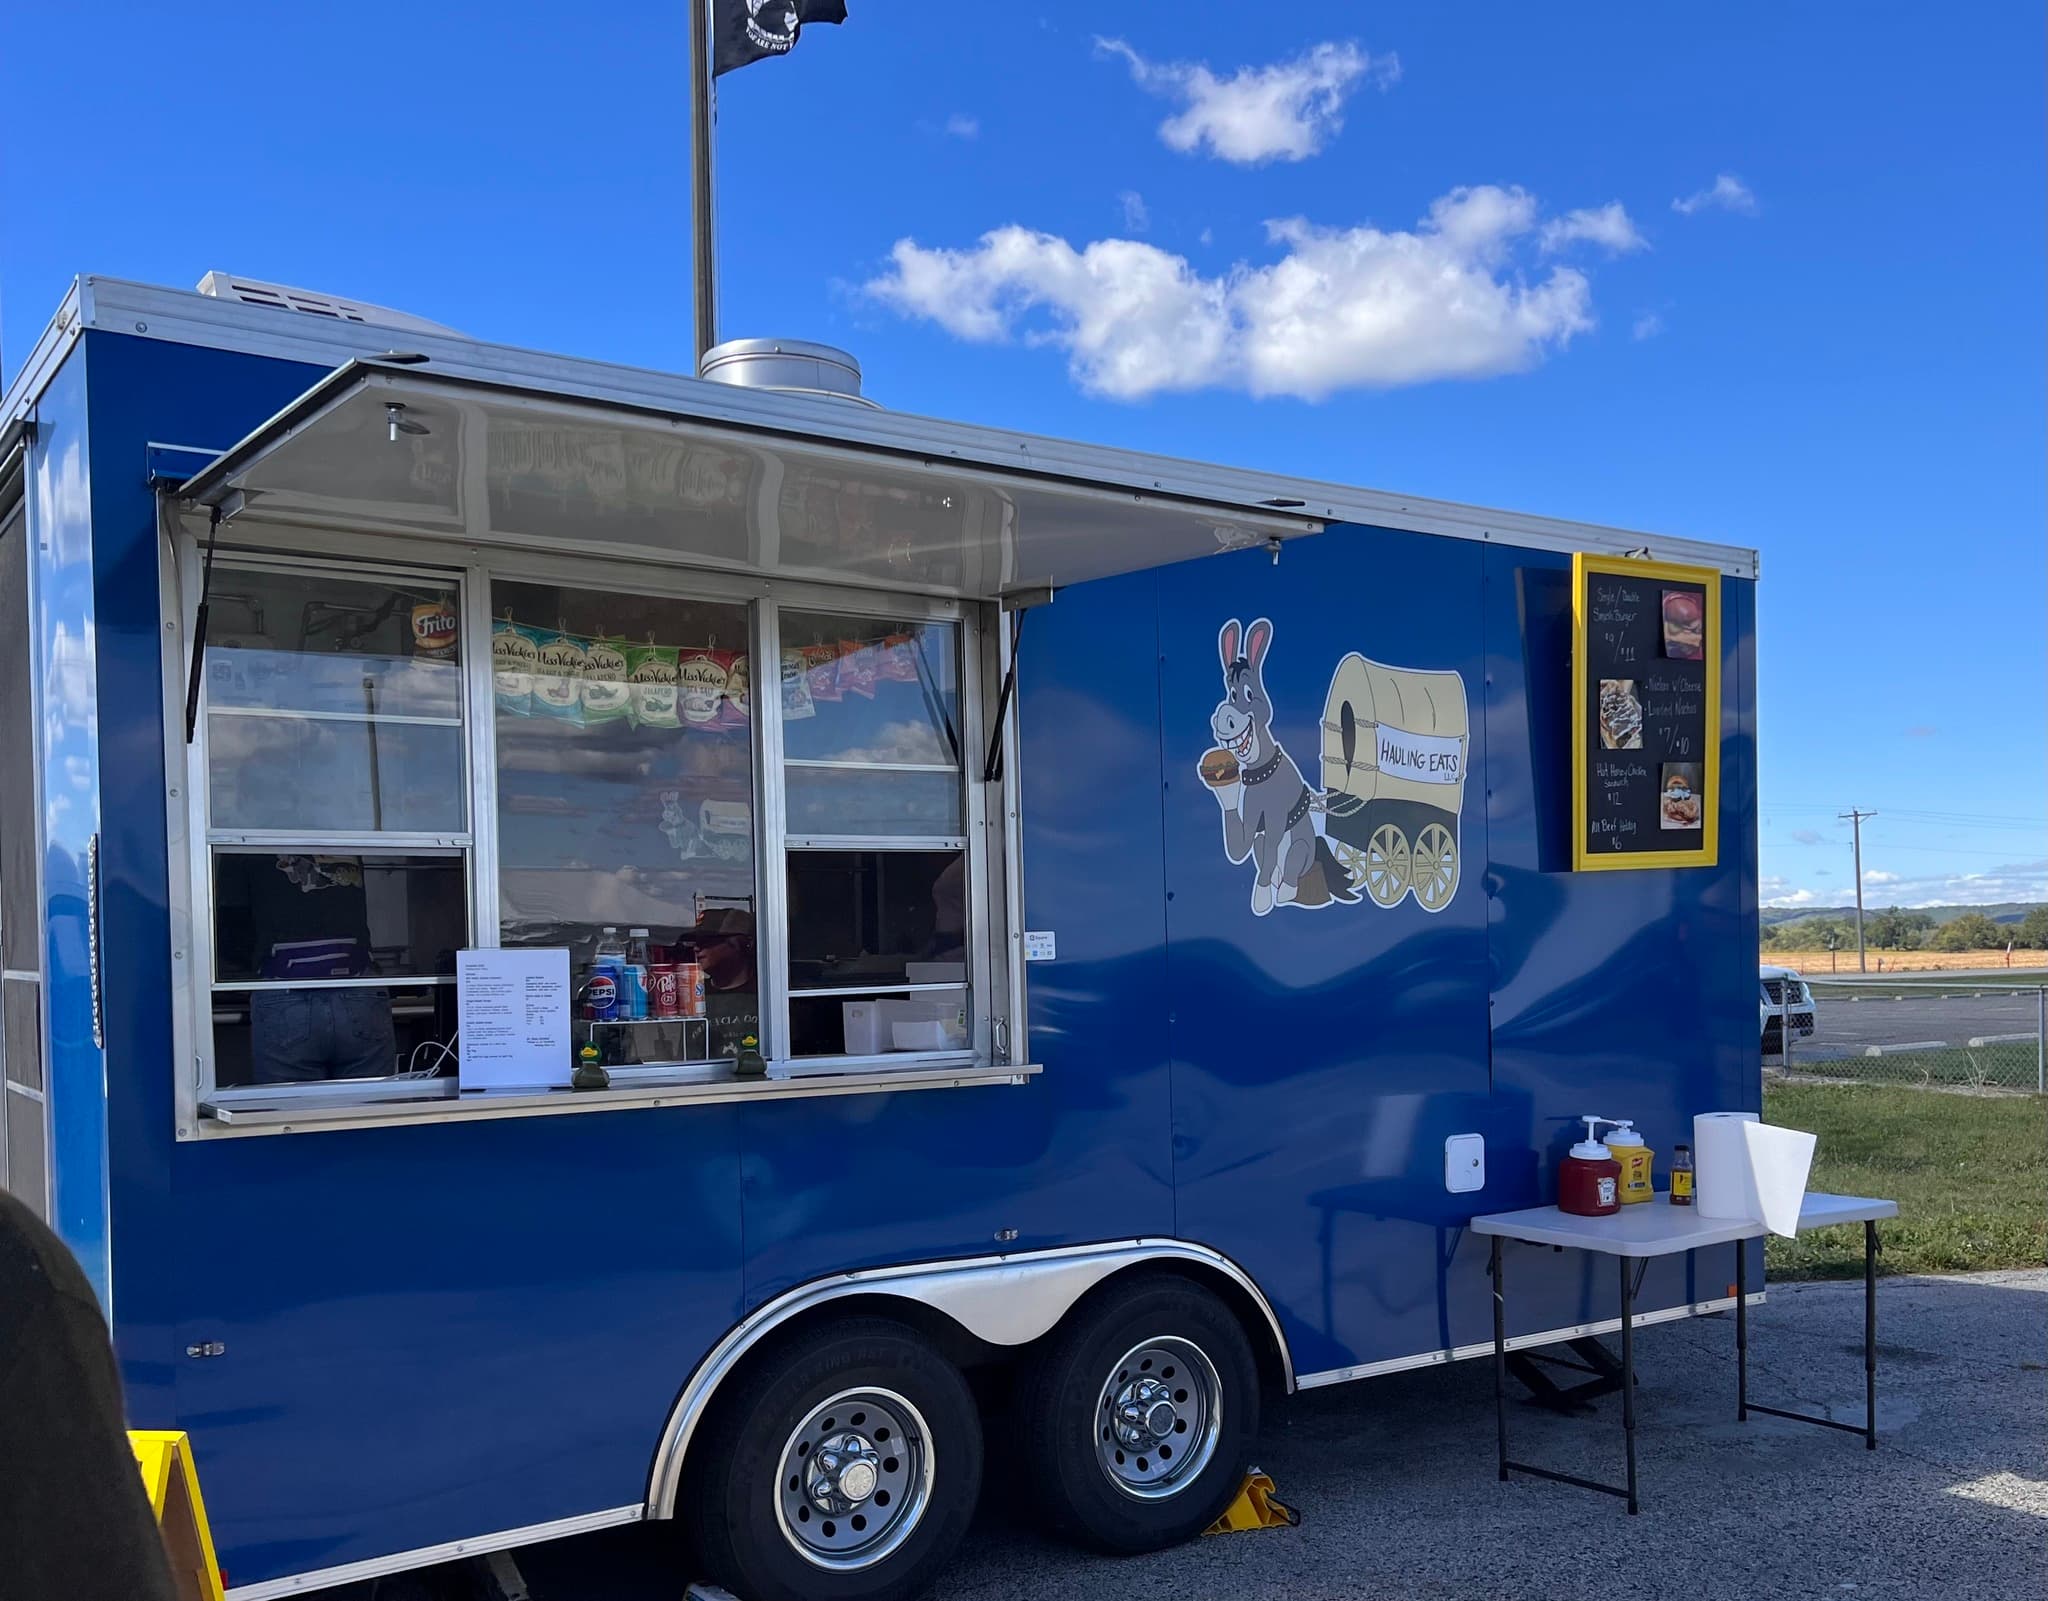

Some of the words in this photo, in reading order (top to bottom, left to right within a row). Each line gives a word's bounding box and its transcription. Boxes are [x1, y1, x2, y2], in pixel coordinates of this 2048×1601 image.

[755, 38, 770, 49] ARE
[770, 43, 788, 51] NOT
[538, 651, 557, 665] Miss
[678, 668, 697, 681] Miss
[1381, 738, 1425, 769] HAULING
[1429, 753, 1458, 772] EATS
[1601, 817, 1616, 832] Beef
[589, 988, 615, 996] PEPSI
